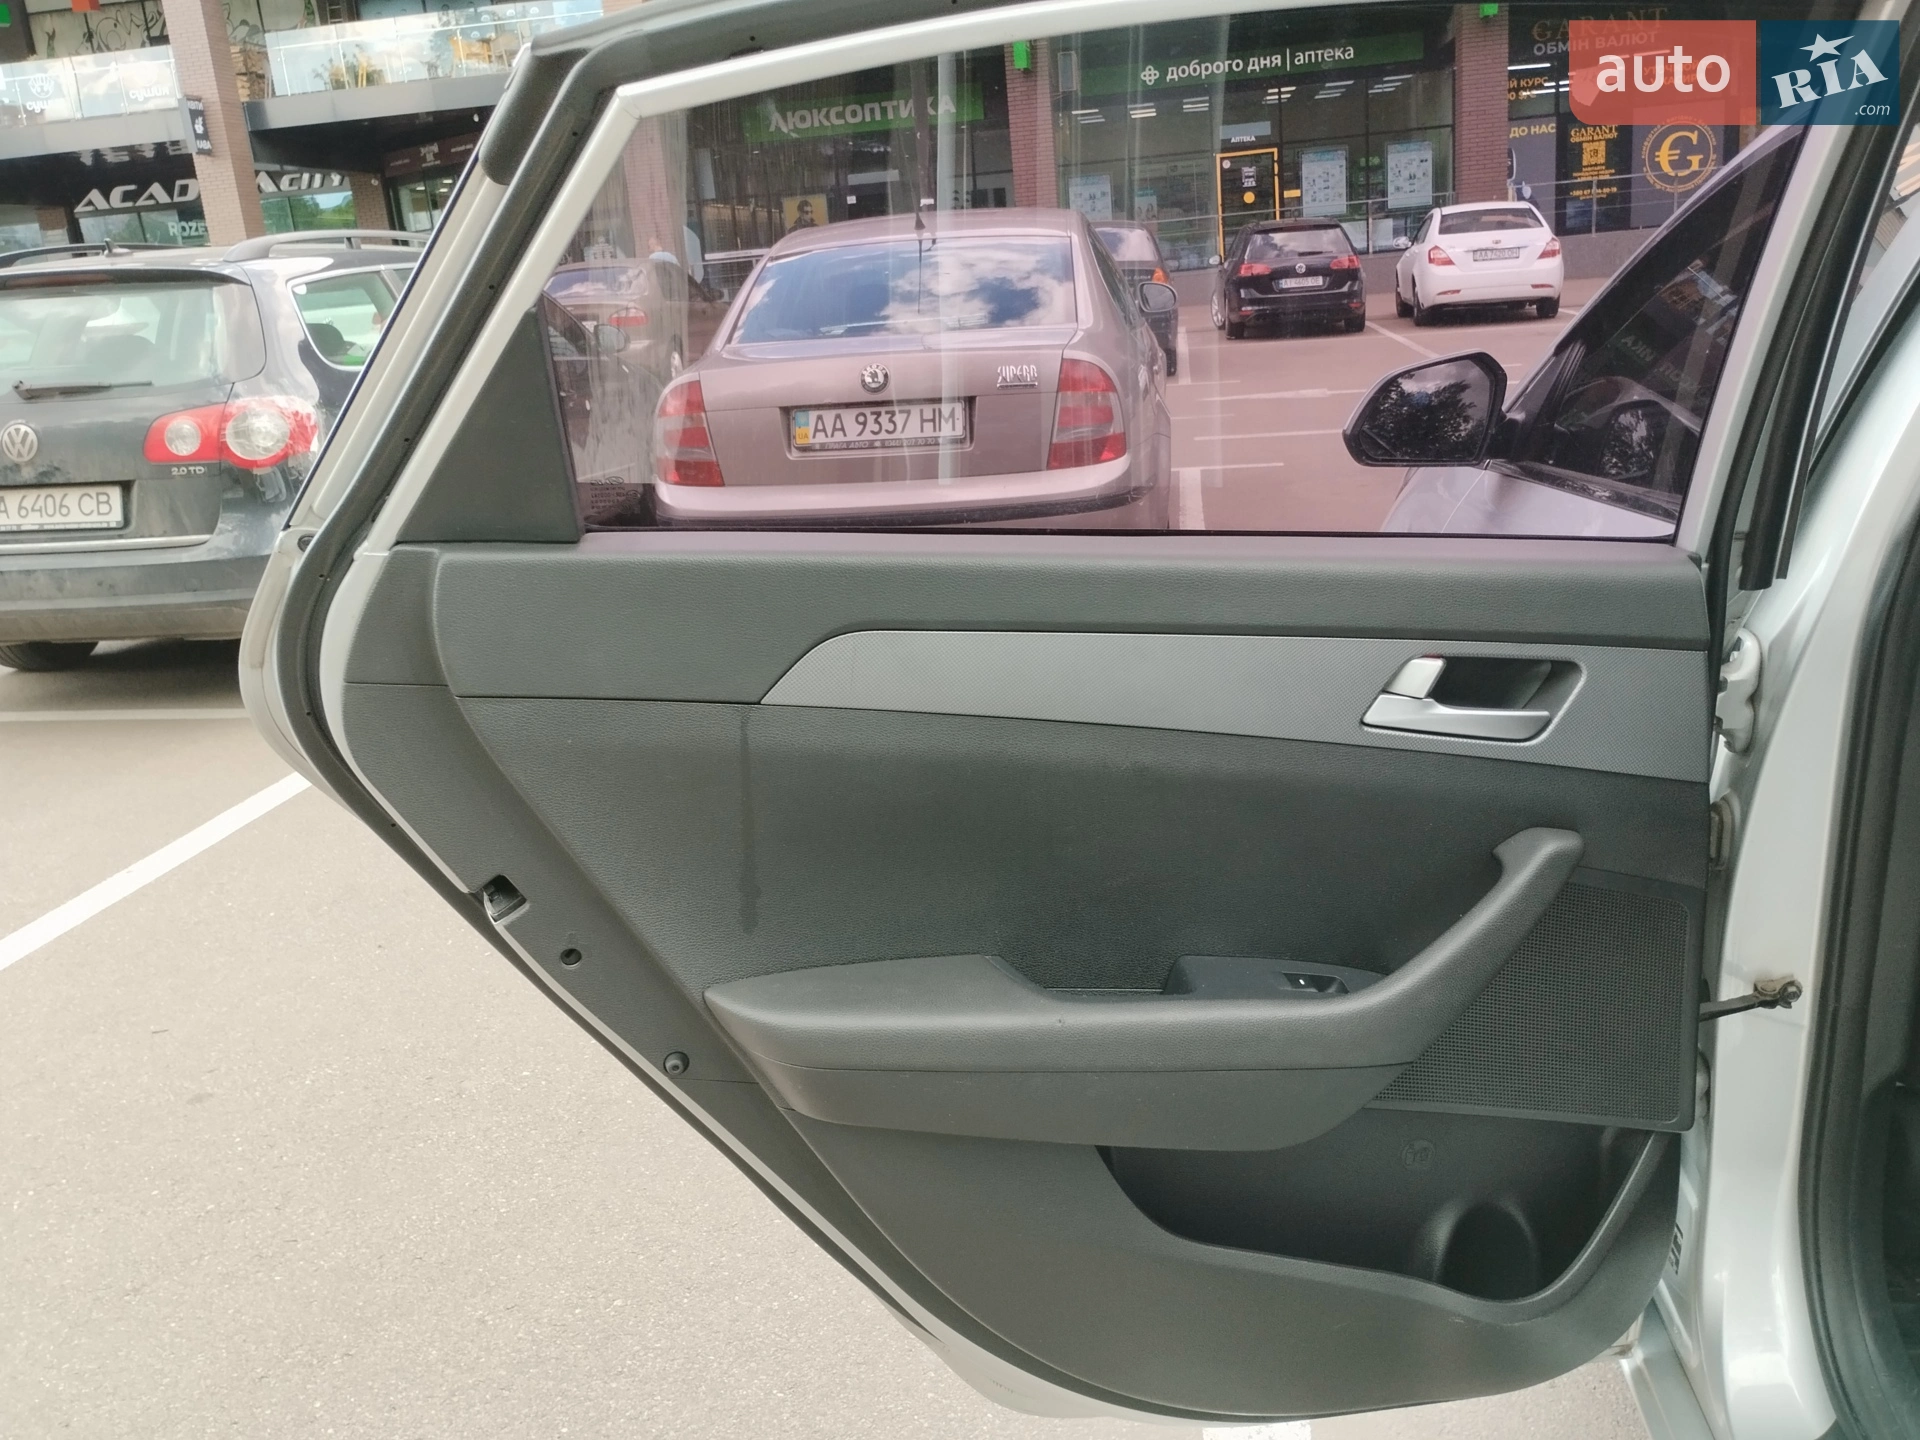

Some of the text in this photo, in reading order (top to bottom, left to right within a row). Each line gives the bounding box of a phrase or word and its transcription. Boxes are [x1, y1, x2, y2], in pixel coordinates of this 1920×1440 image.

[1167, 46, 1354, 83] доброго дня аптека
[1509, 123, 1556, 138] ДО НАС
[168, 221, 206, 237] ROZE
[812, 406, 956, 440] AA 9337 HM
[17, 493, 71, 518] 6406
[78, 492, 113, 516] CB
